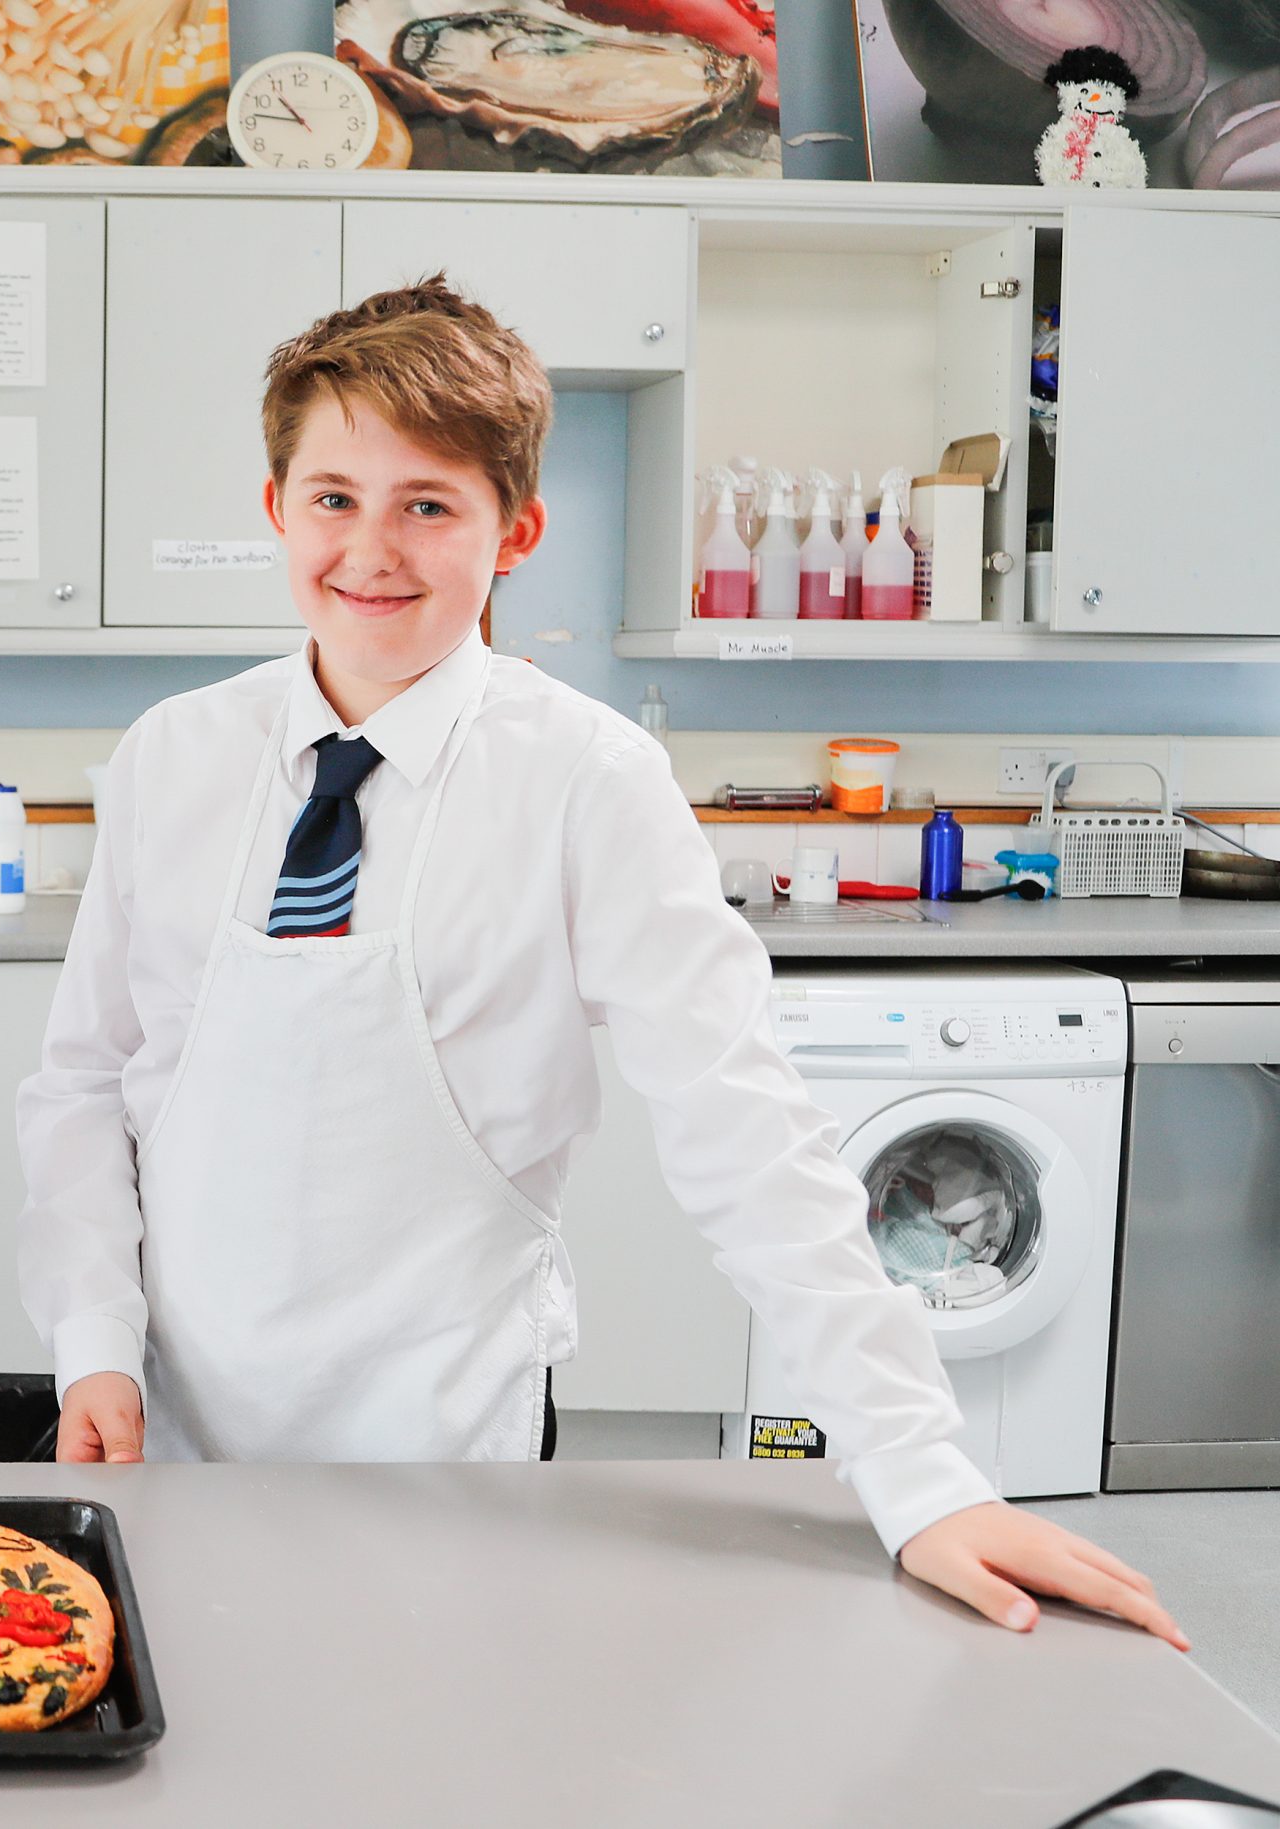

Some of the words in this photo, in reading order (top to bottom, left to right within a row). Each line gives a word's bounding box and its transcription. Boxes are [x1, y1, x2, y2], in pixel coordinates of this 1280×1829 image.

[291, 72, 309, 87] 12
[271, 80, 283, 92] 11
[323, 80, 328, 92] 1
[254, 94, 271, 108] 10
[339, 94, 350, 109] 2
[245, 115, 257, 131] 9
[347, 116, 360, 131] 3
[253, 137, 266, 152] 8
[342, 139, 352, 151] 4
[273, 153, 283, 167] 7
[324, 153, 336, 168] 5
[751, 642, 788, 653] Muscle
[779, 1013, 809, 1023] ZANUSSI
[754, 1418, 791, 1429] REGISTER
[792, 1420, 811, 1430] NOW
[762, 1427, 796, 1437] ACTIVATE
[797, 1428, 817, 1438] YOUR
[753, 1435, 773, 1445] FREE
[774, 1436, 818, 1446] GUARANTEE
[753, 1447, 771, 1457] 0800
